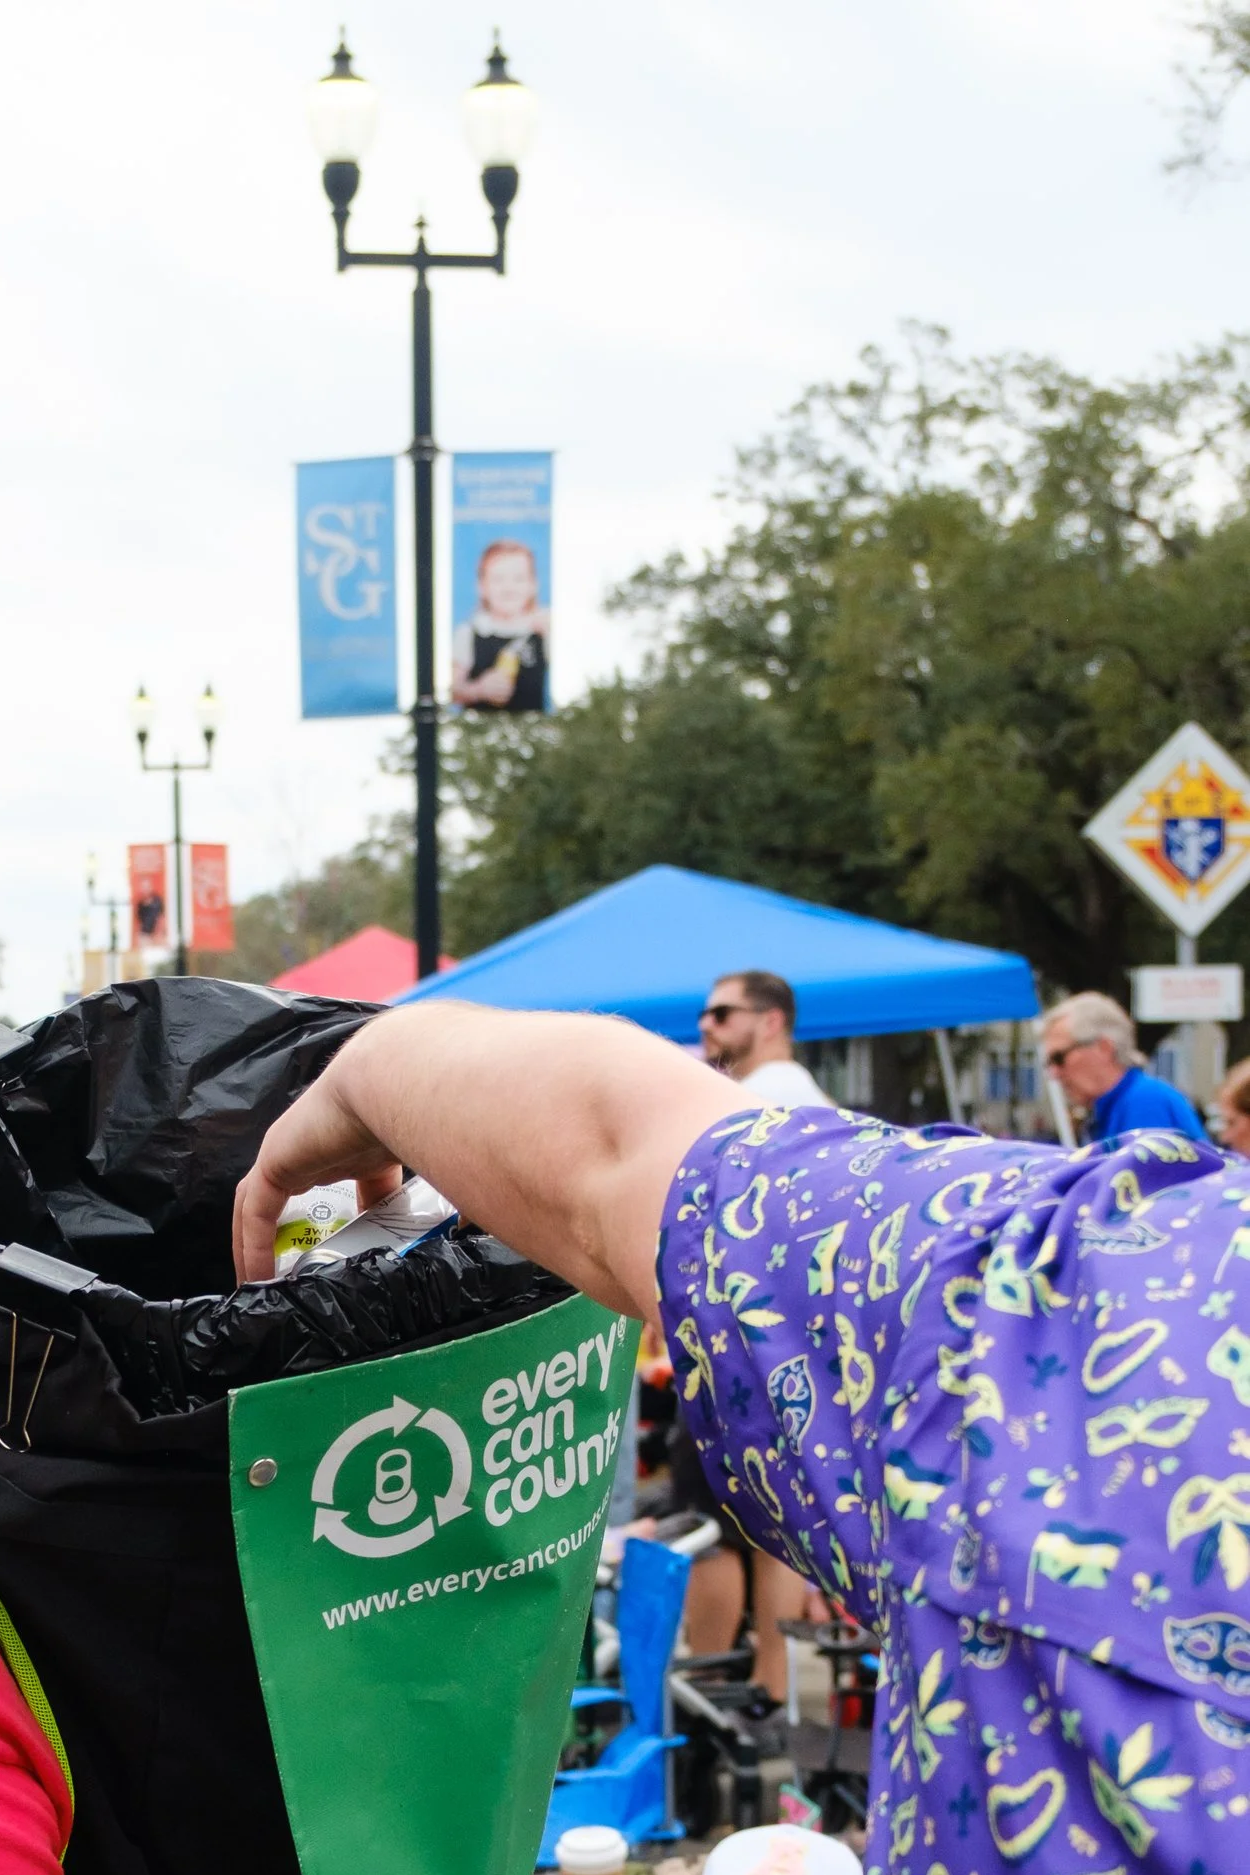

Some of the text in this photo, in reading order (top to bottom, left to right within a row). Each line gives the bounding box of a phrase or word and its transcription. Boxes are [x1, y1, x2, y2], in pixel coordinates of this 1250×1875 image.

[482, 1322, 617, 1426] every
[483, 1399, 574, 1476] can
[485, 1407, 621, 1527] counts
